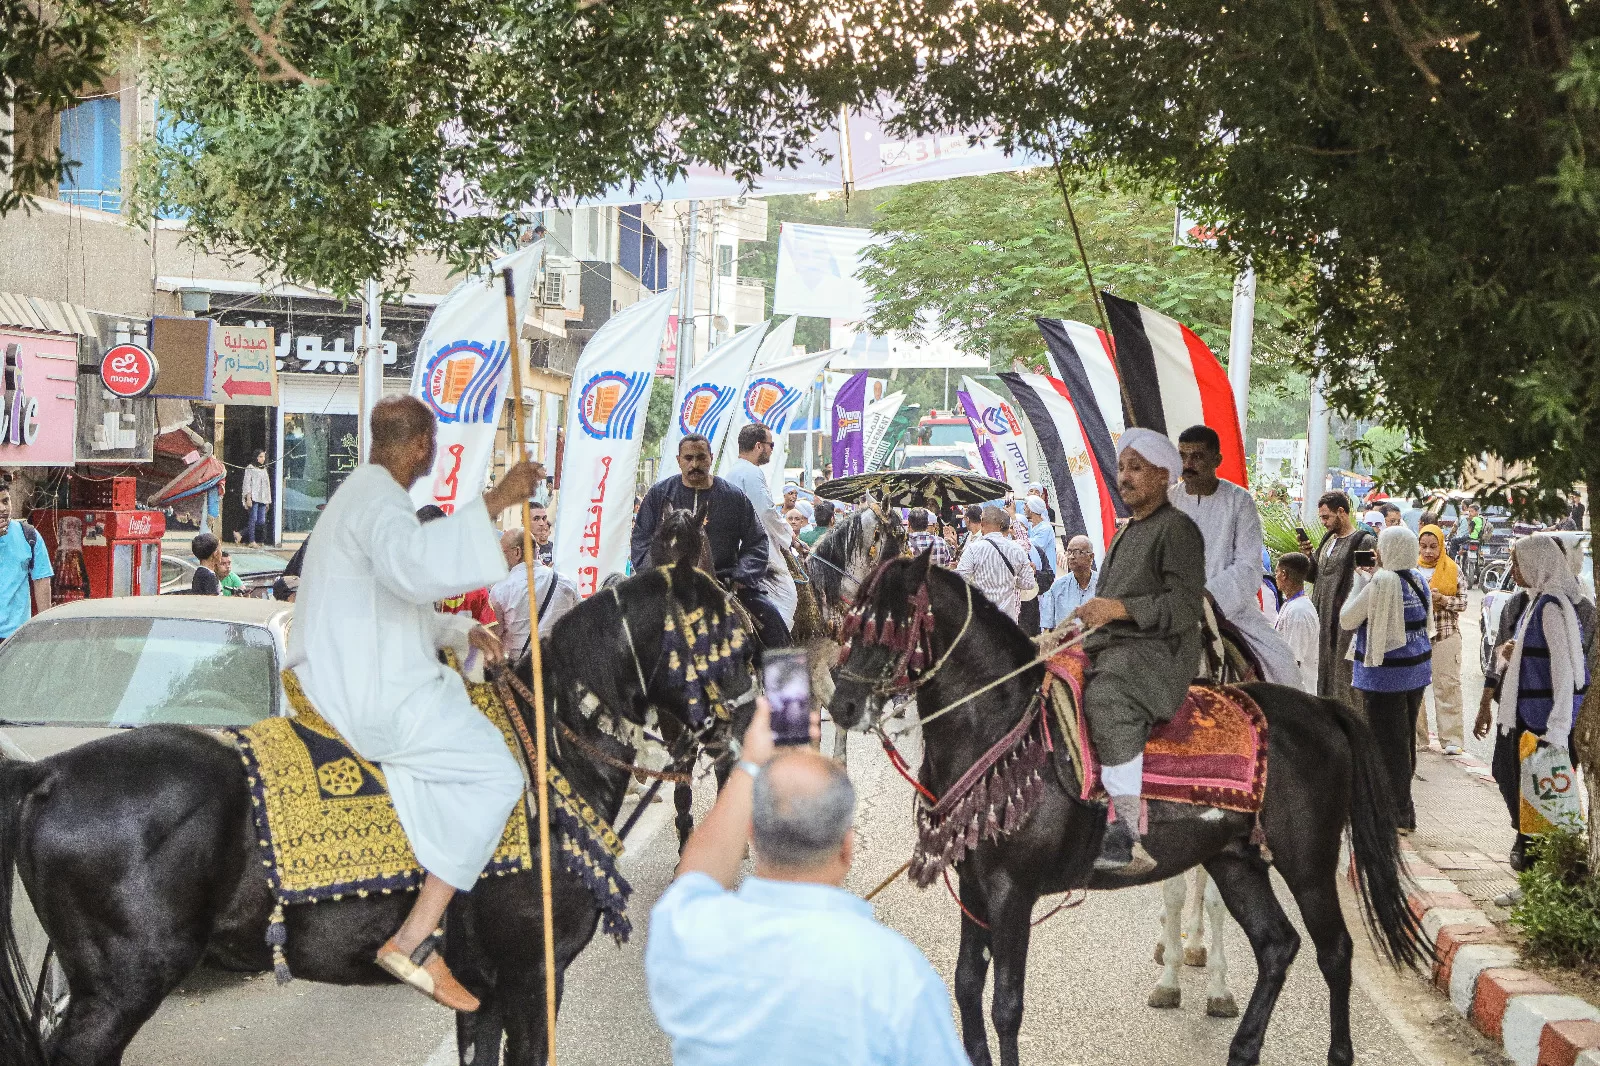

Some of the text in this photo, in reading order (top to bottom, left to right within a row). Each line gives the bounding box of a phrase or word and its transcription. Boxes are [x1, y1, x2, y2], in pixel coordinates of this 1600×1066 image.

[224, 331, 268, 353] صيدلية
[224, 354, 269, 374] زمزم
[110, 375, 140, 386] money
[432, 368, 444, 397] QENA
[0, 343, 39, 446] ic
[586, 393, 595, 418] QENA
[872, 415, 891, 445] CEMENT
[577, 456, 613, 600] محافظة قنا
